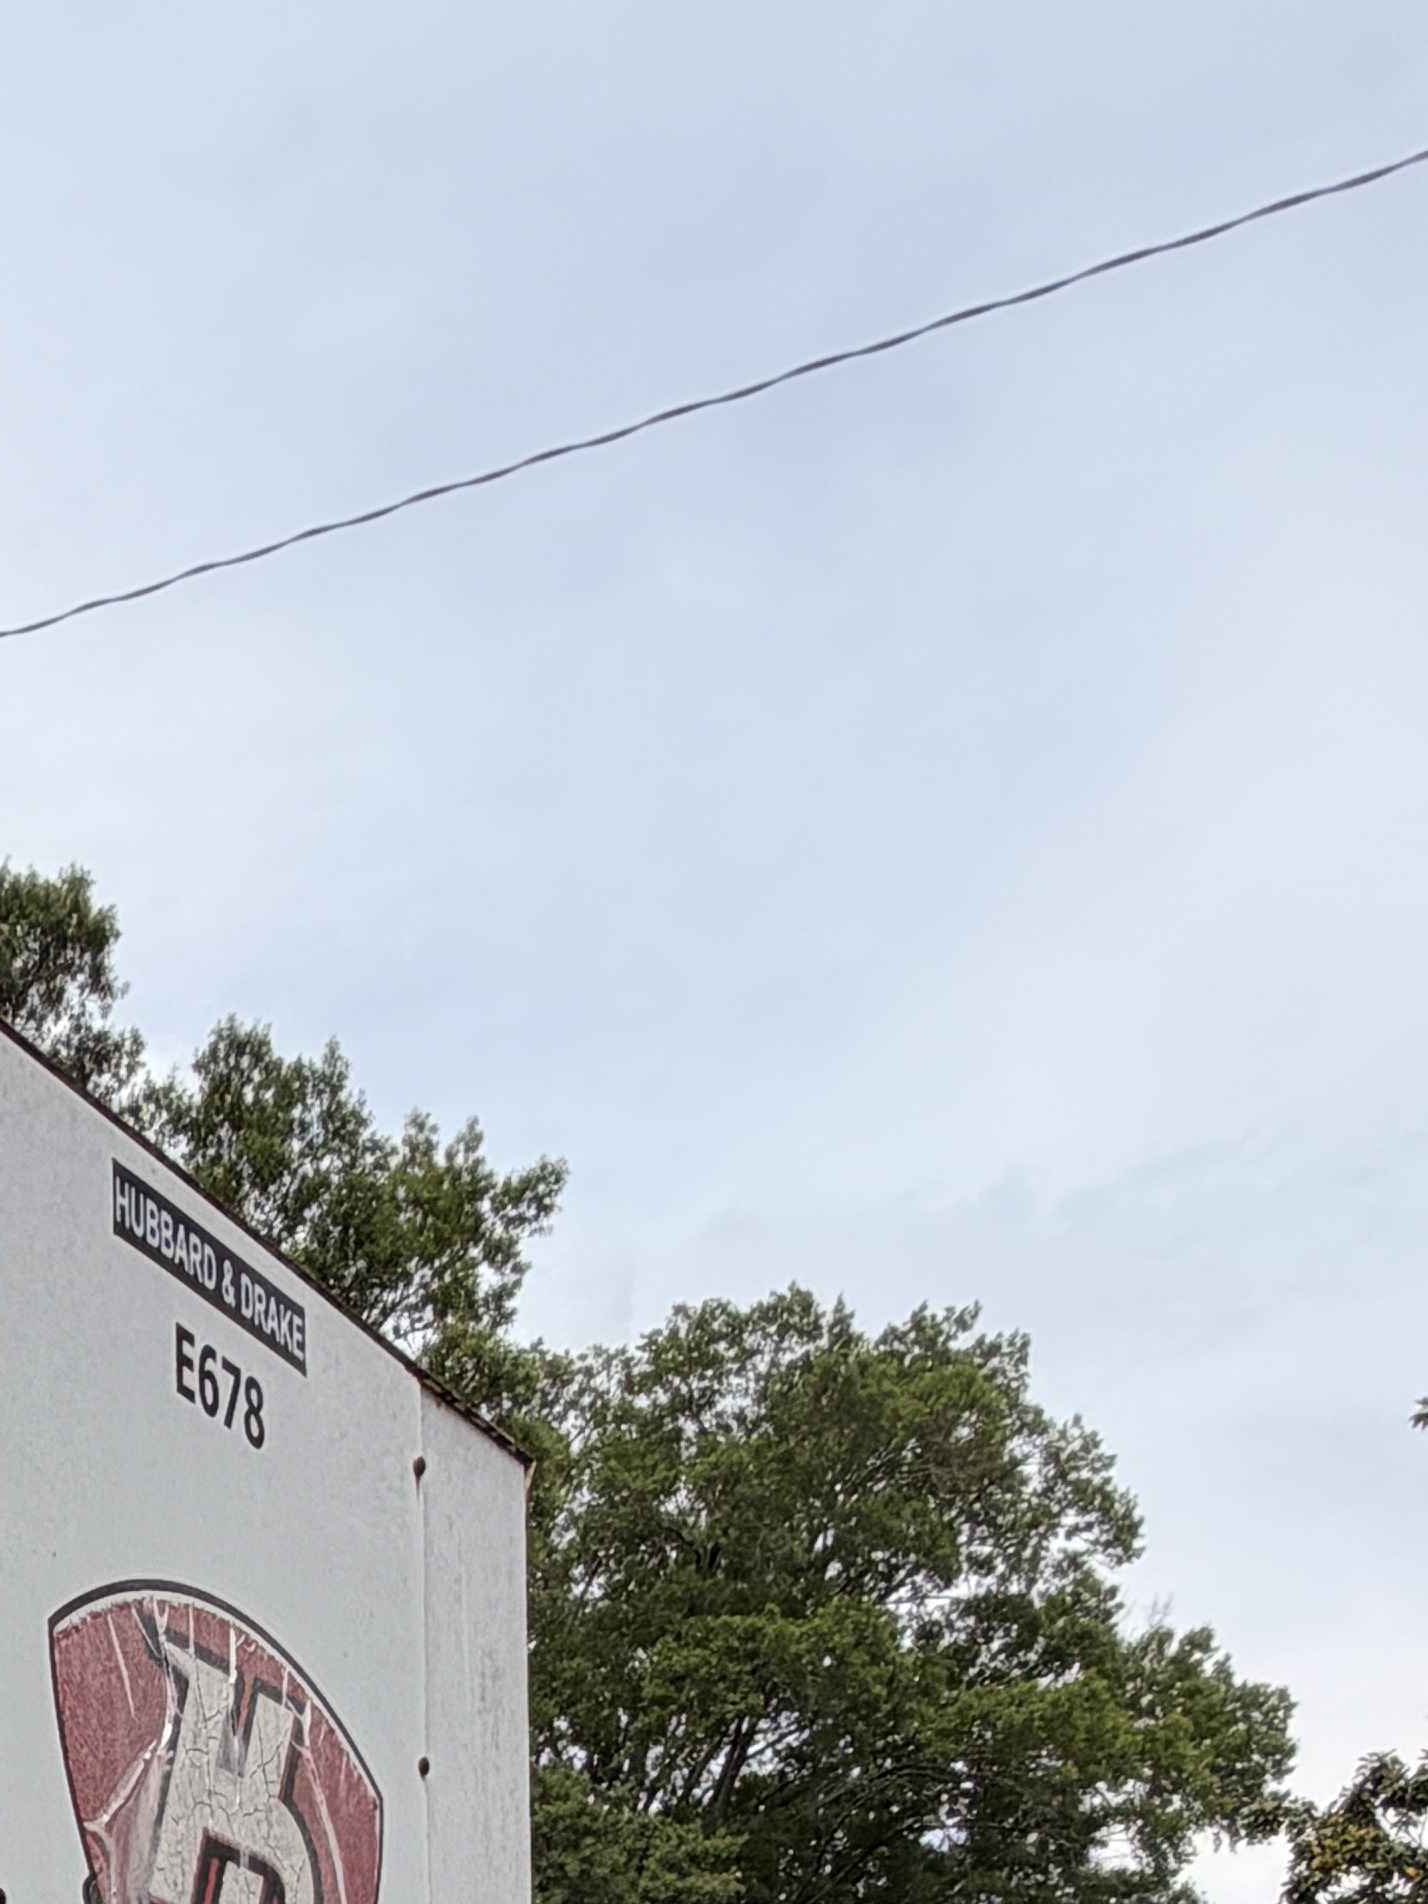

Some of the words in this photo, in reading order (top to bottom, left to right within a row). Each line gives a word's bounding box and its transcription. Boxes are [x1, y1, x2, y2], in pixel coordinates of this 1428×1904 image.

[115, 1176, 217, 1291] HUBBARD
[222, 1259, 236, 1308] &
[241, 1273, 304, 1360] DRAKE
[176, 1321, 265, 1450] E678
